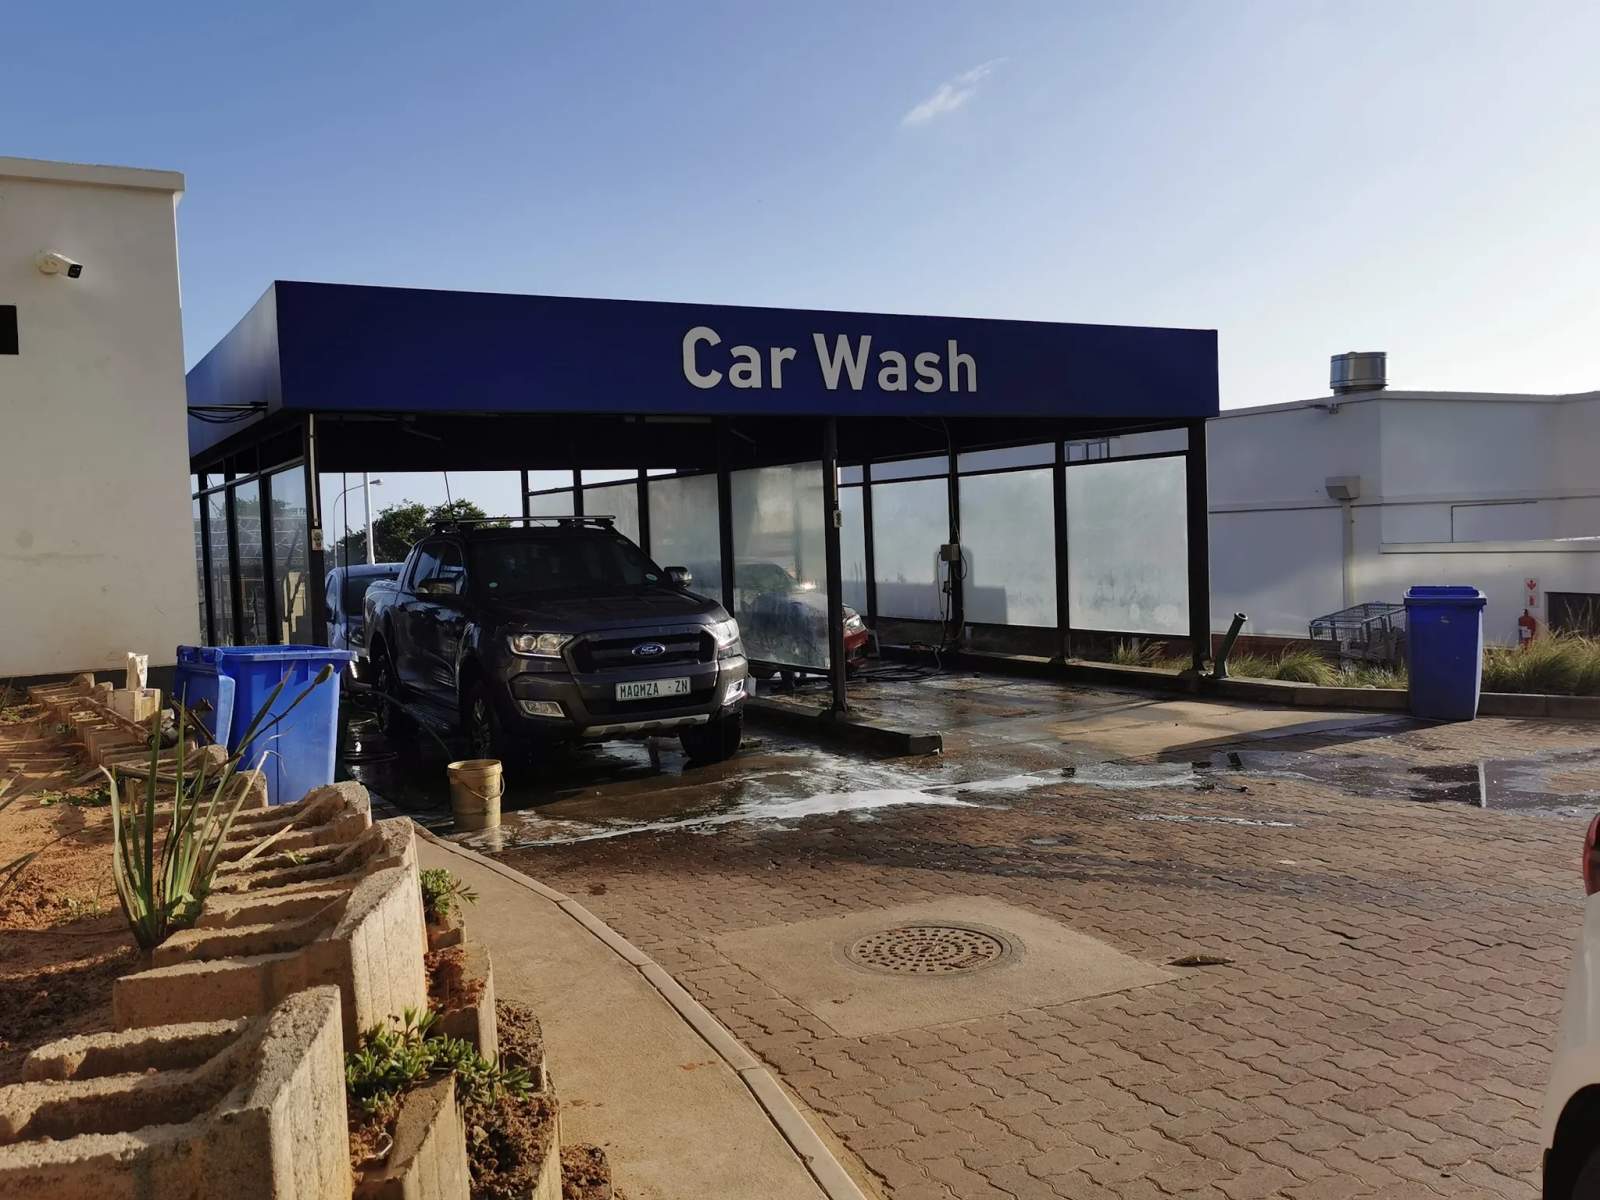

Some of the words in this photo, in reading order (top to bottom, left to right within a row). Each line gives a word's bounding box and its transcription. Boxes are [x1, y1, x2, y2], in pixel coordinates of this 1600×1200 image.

[682, 326, 797, 389] Car
[813, 333, 977, 392] Wash
[675, 680, 688, 693] ZN
